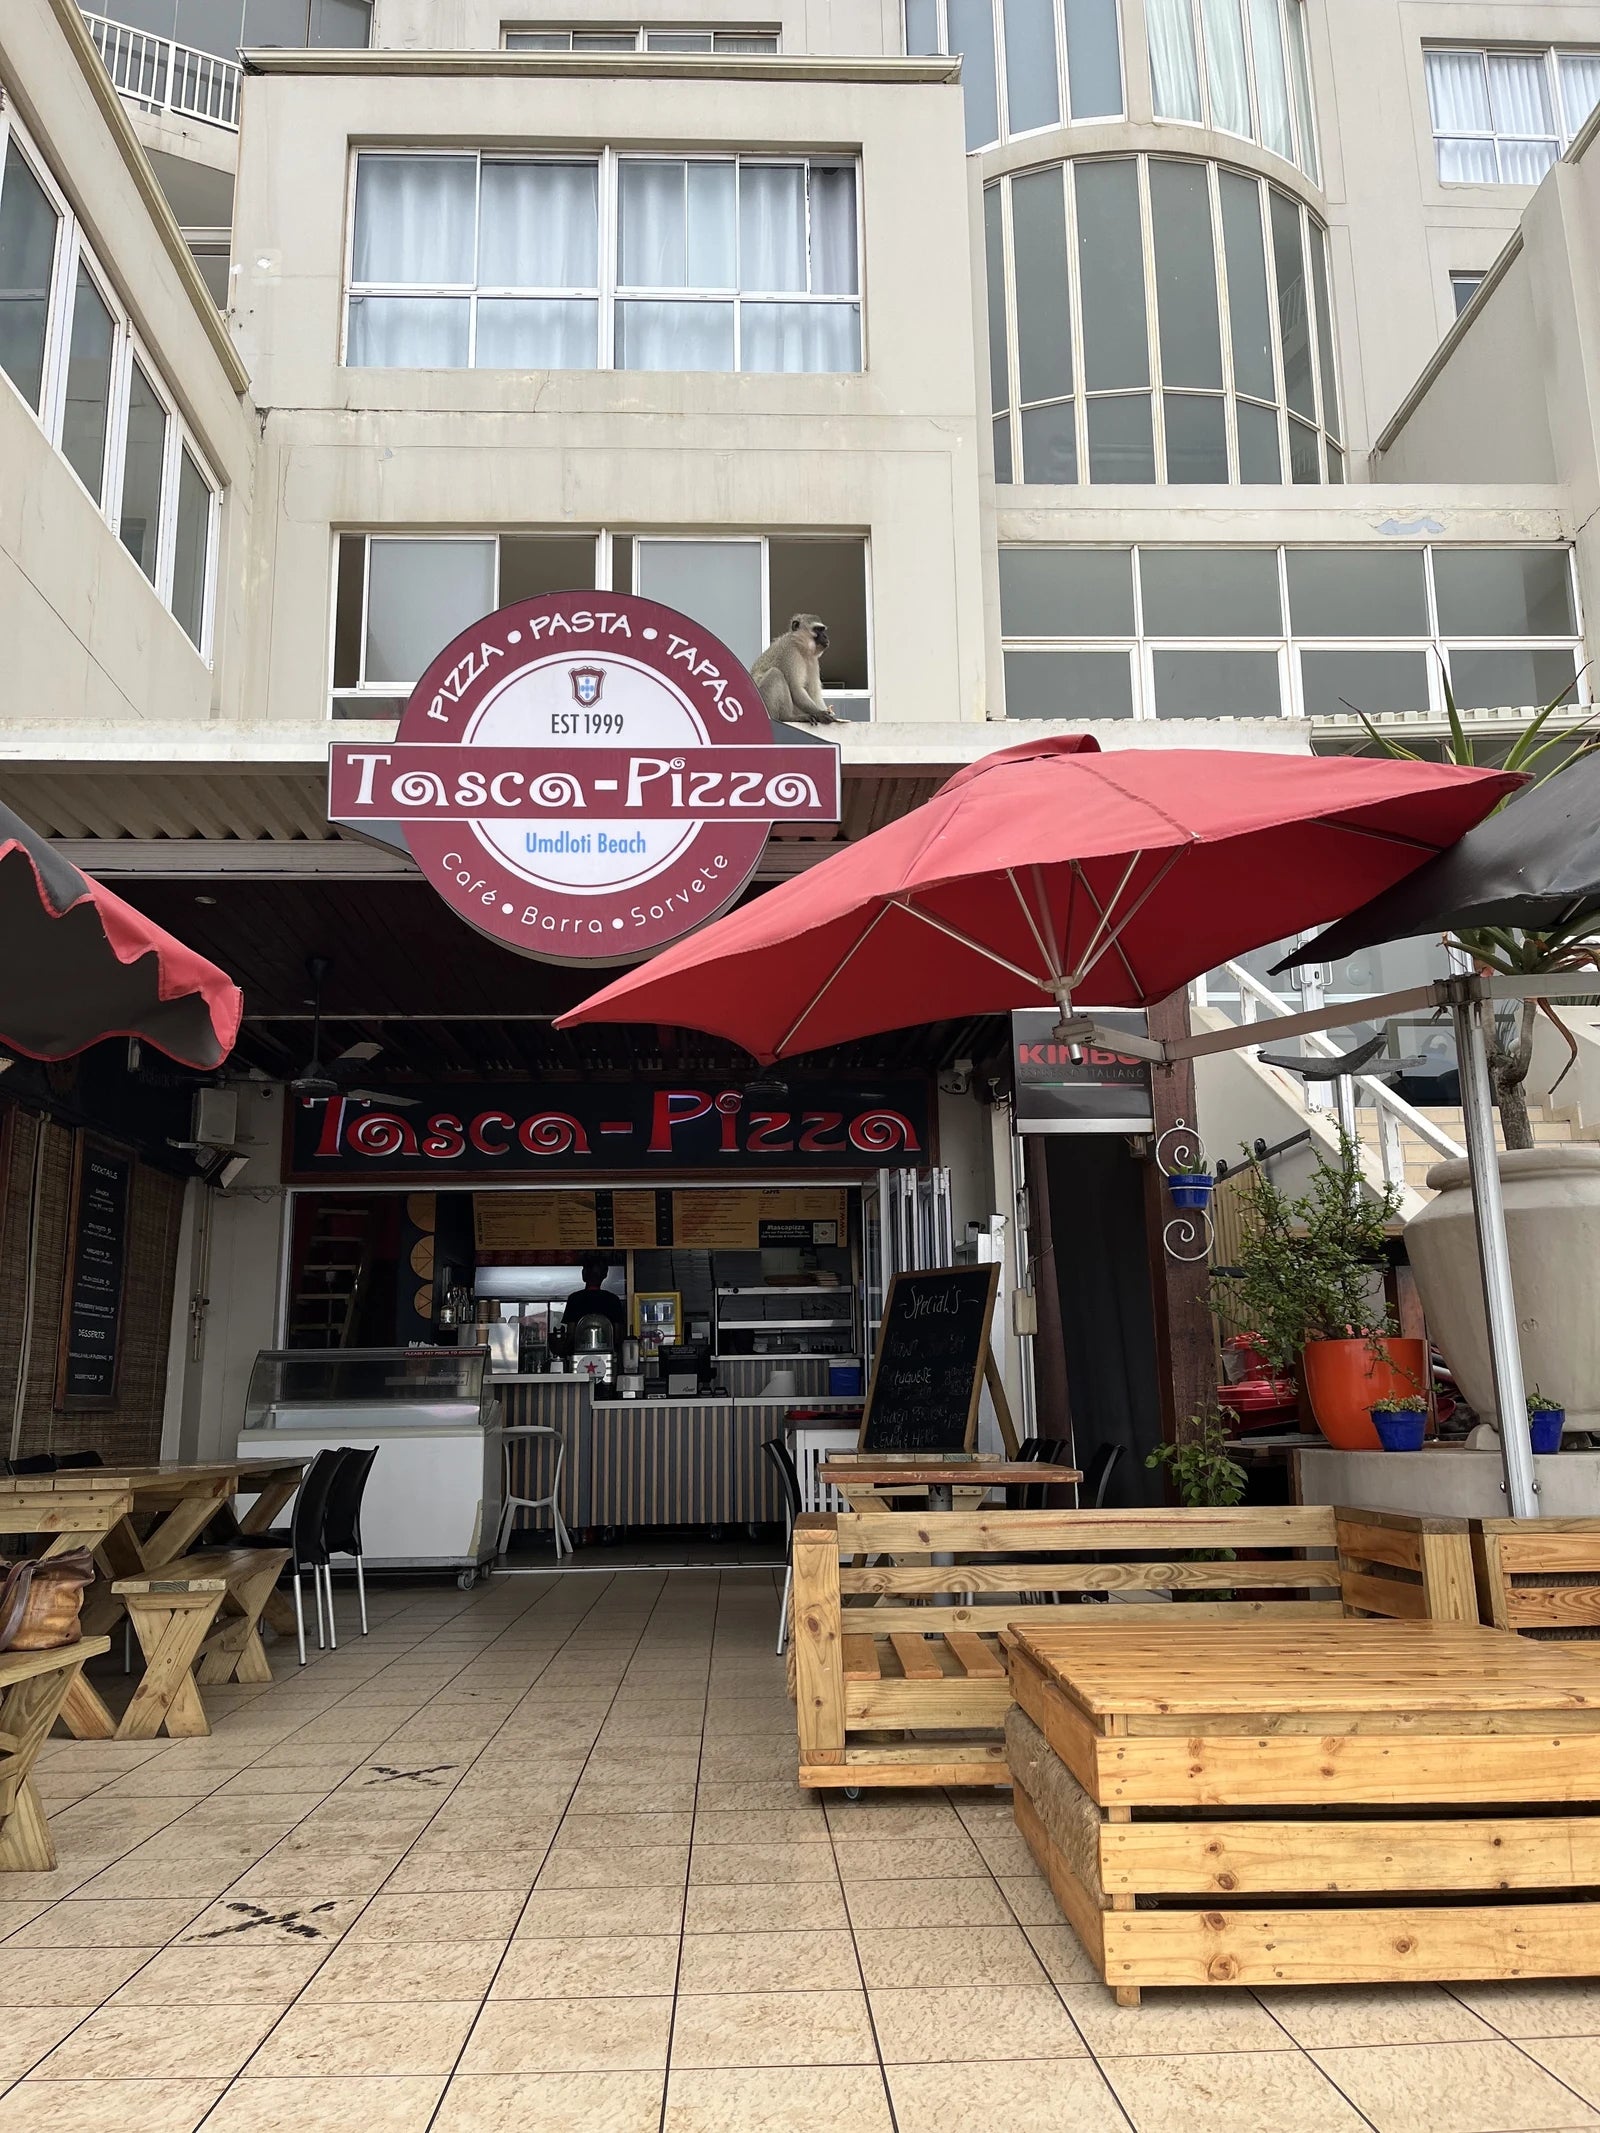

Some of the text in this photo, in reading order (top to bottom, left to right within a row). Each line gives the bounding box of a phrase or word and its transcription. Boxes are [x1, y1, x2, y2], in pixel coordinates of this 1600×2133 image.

[427, 611, 744, 723] PIZZA PASTA TAPAS
[551, 713, 625, 735] EST 1999
[346, 753, 823, 808] Tasca-Pizza
[525, 831, 646, 854] Umdloti Beach
[442, 852, 729, 935] Café Barra Sorvete
[78, 1328, 105, 1340] DESSERTS
